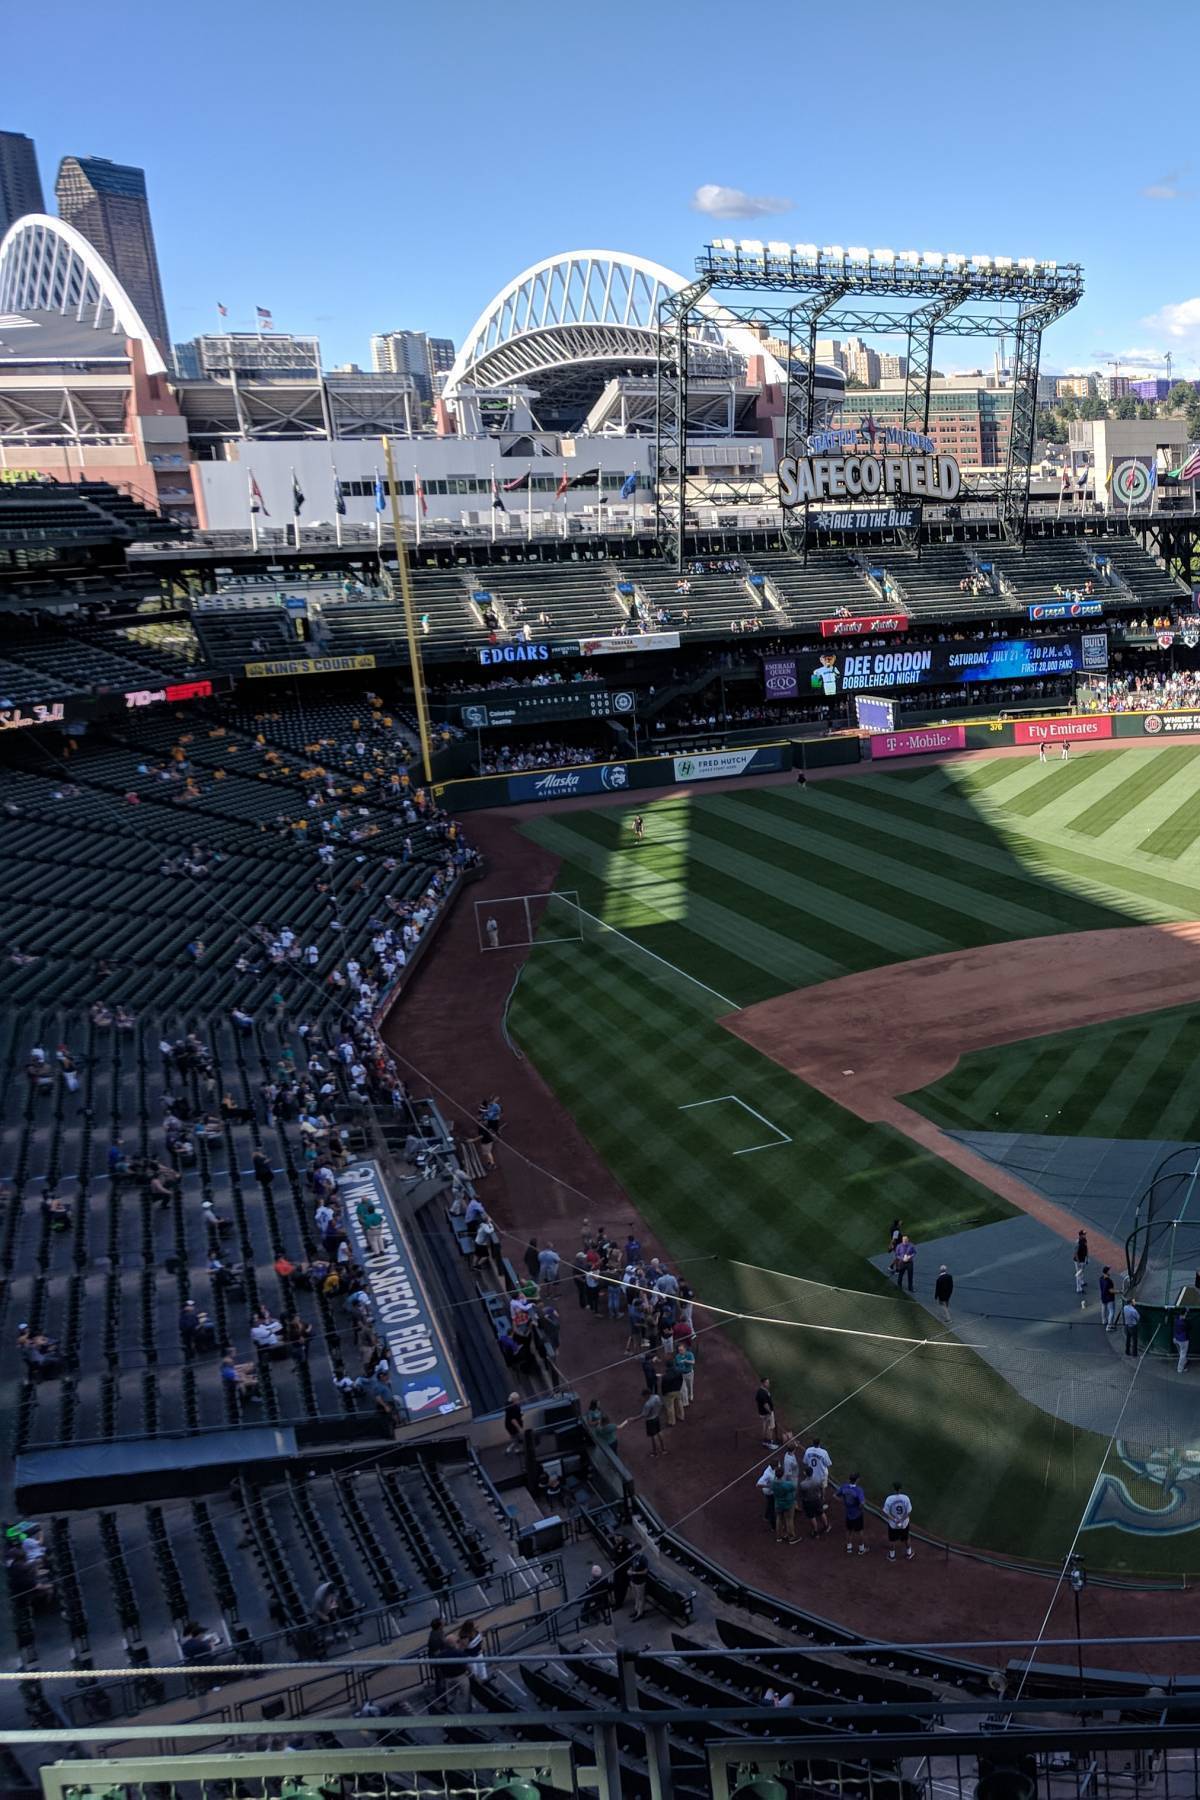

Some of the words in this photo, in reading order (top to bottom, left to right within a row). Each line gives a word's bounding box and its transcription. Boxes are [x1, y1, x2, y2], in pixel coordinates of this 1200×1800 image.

[807, 430, 857, 455] SEATTLE
[884, 428, 935, 454] MARINERS
[778, 455, 881, 507] SAFECO
[884, 454, 961, 501] FIELD
[829, 511, 856, 529] TRUE
[856, 513, 869, 527] TO
[869, 512, 887, 527] THE
[889, 510, 913, 526] BLUE
[1045, 606, 1066, 617] pepsi
[1082, 604, 1102, 615] pepsi
[833, 622, 862, 633] xfinity
[870, 619, 898, 632] xfinity
[1084, 637, 1105, 648] BUILT
[264, 660, 309, 674] KING'S
[314, 658, 356, 671] COURT
[765, 662, 795, 670] EMERALD
[844, 656, 871, 676] DEE
[874, 651, 931, 674] GORDON
[949, 652, 989, 666] SATURDAY,
[991, 651, 1008, 662] JULY
[1022, 663, 1038, 673] FIRST
[1059, 659, 1073, 670] FANS
[1085, 656, 1106, 665] TOUGH
[842, 673, 895, 690] BOBBLEHEAD
[896, 670, 920, 685] NIGHT
[1163, 715, 1193, 724] WHERE
[1173, 722, 1193, 730] FAST
[1028, 725, 1048, 739] Fly
[1049, 722, 1098, 736] Emirates
[699, 758, 719, 767] FRED
[720, 756, 747, 765] HUTCH
[534, 773, 580, 789] Alaska
[538, 787, 577, 796] AIRLINES
[368, 1266, 420, 1324] SAFECO
[387, 1323, 437, 1375] FIELD
